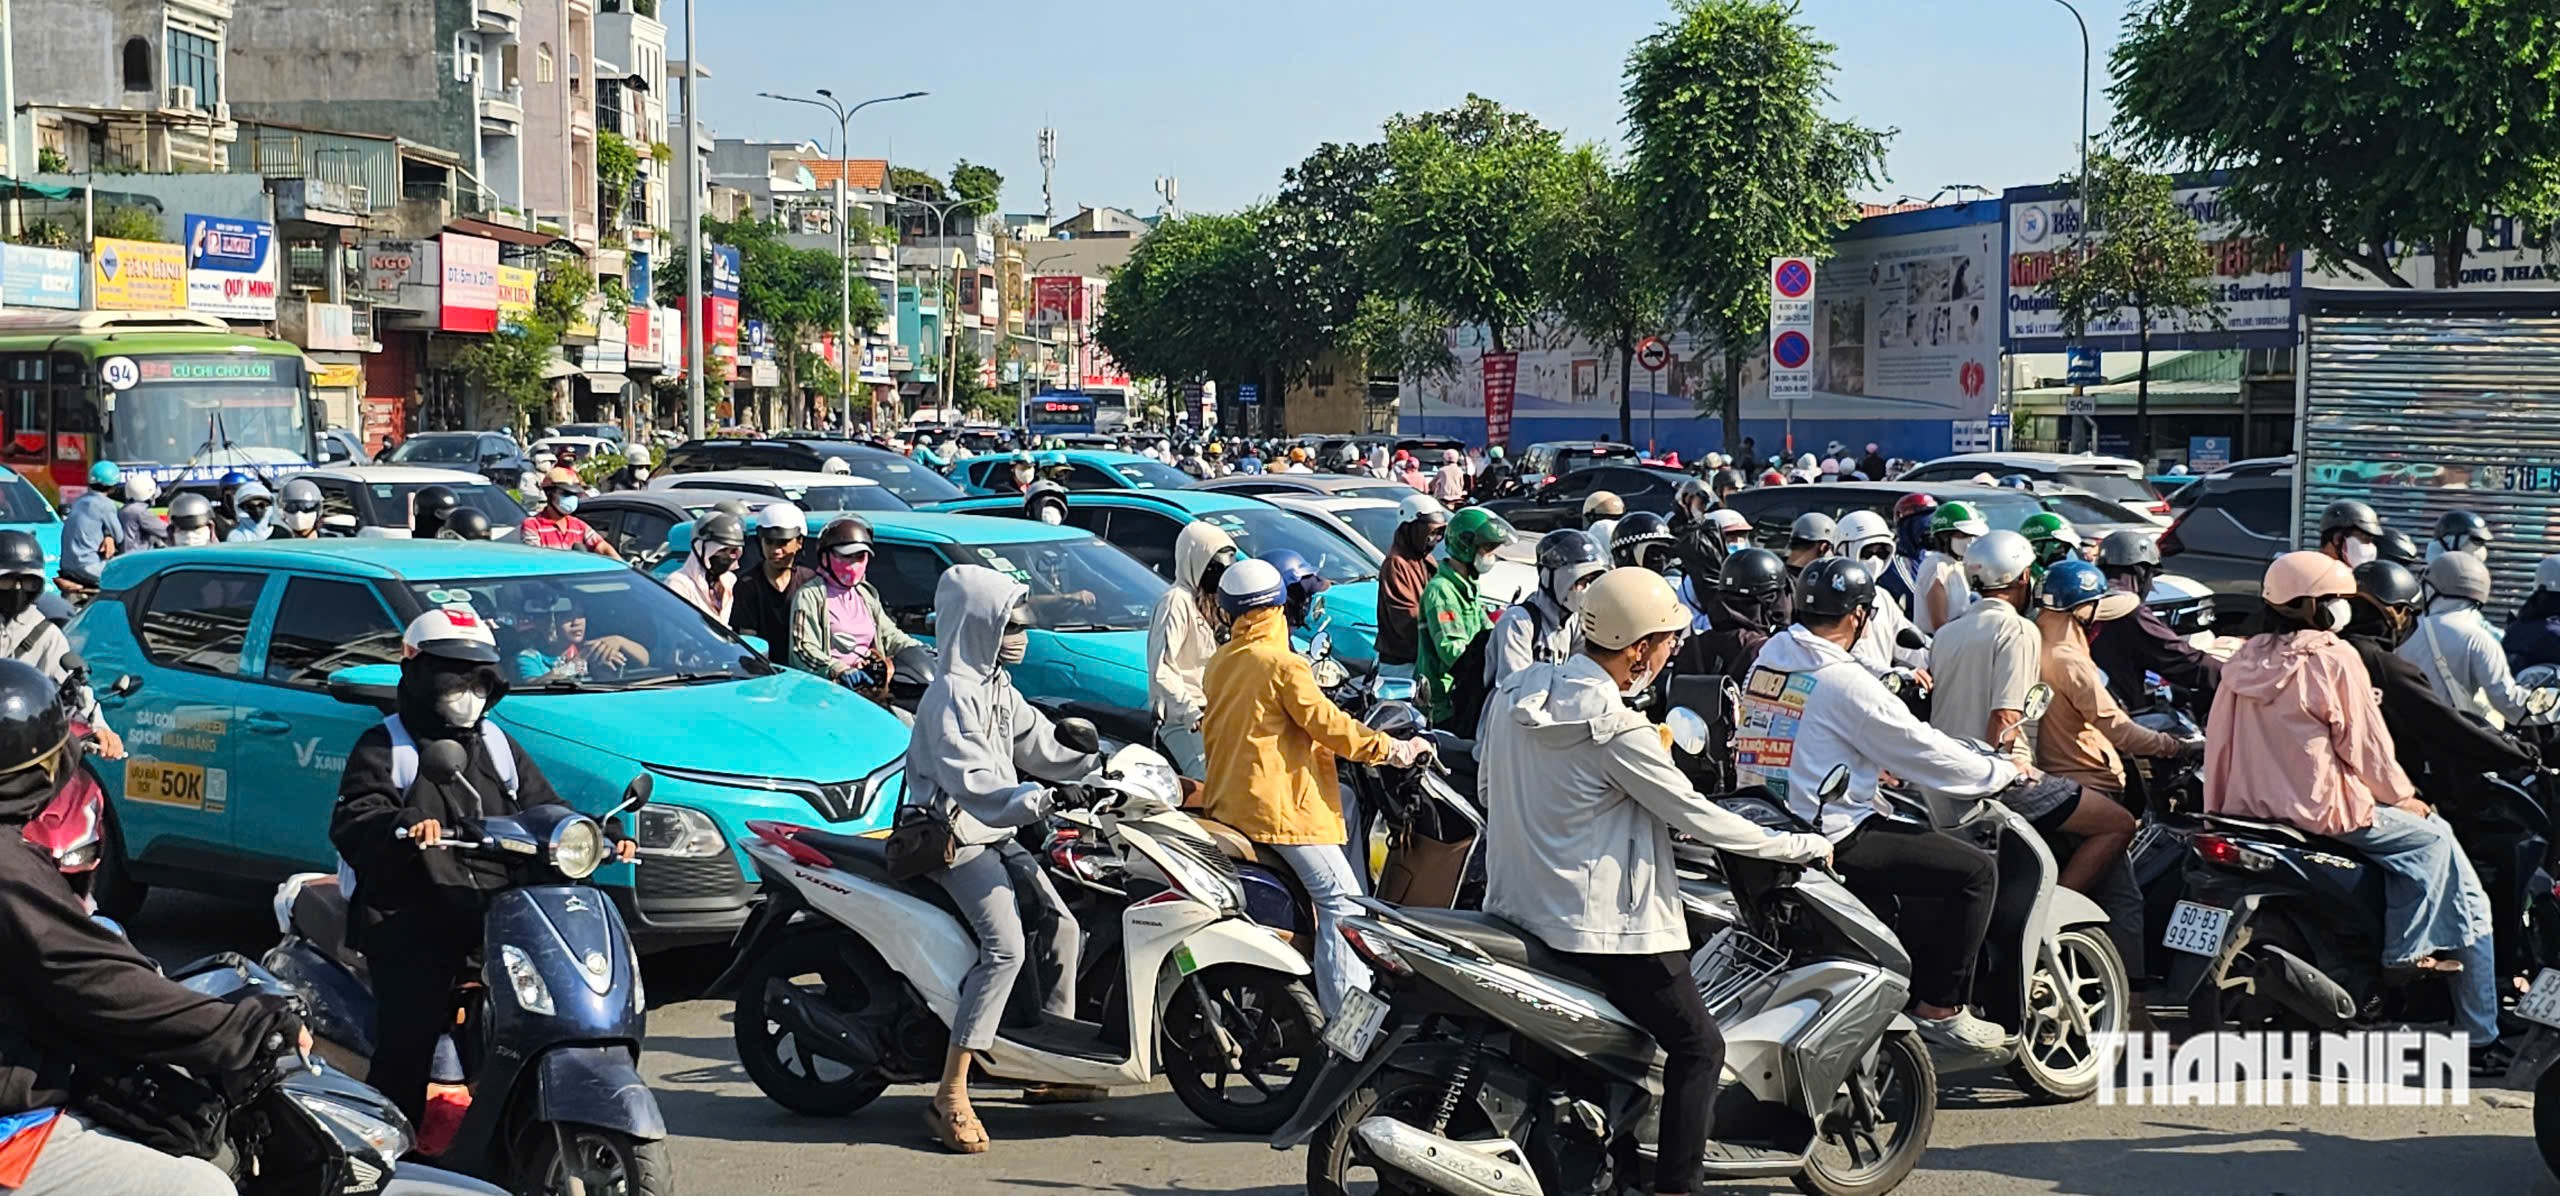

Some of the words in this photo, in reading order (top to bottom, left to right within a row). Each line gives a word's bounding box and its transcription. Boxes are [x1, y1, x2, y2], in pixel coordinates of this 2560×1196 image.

[110, 364, 132, 383] 94
[2070, 400, 2093, 411] 50m
[161, 769, 202, 801] 50K
[795, 869, 852, 895] VISION
[1132, 919, 1163, 927] HONDA
[2167, 925, 2218, 953] 992.58
[342, 1183, 379, 1194] HONDA
